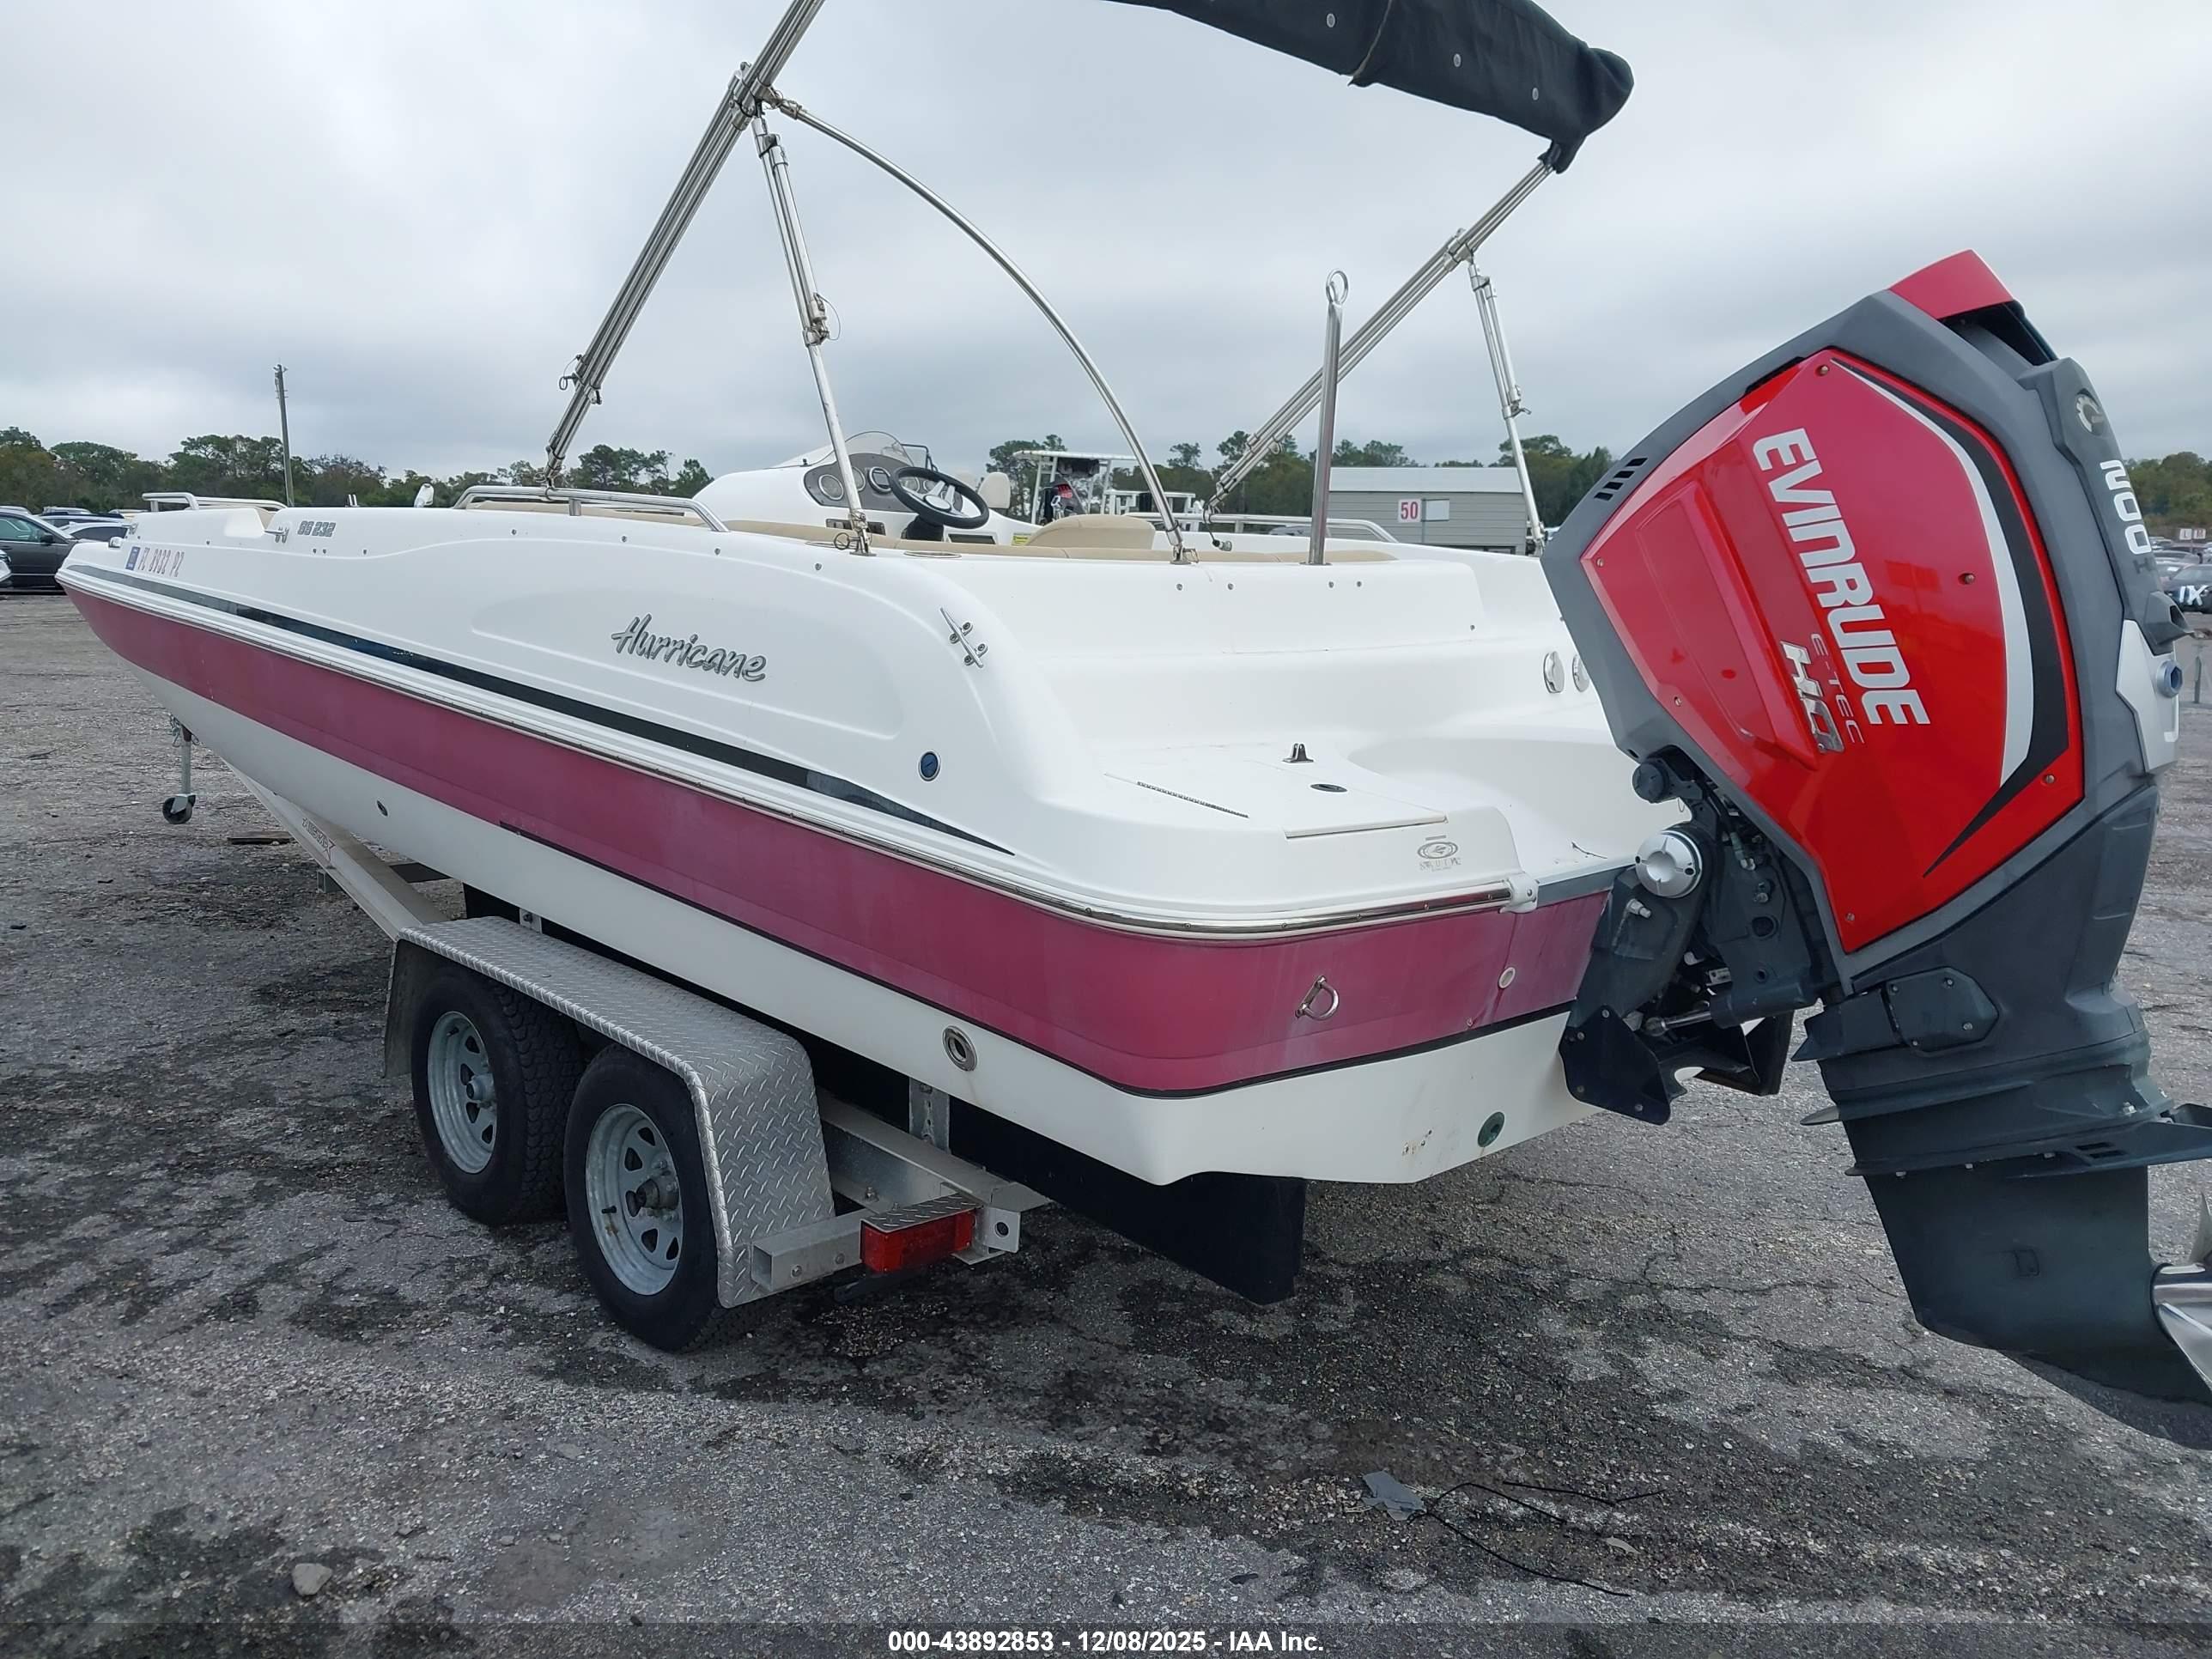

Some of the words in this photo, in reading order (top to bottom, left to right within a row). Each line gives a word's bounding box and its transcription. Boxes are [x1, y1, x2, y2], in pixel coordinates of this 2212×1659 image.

[312, 521, 337, 538] 232
[1401, 501, 1419, 520] 50
[2100, 459, 2153, 555] 200
[1753, 428, 1931, 725] EVINRUDE
[611, 613, 767, 683] Hurricane
[1811, 634, 1865, 744] E-TEC
